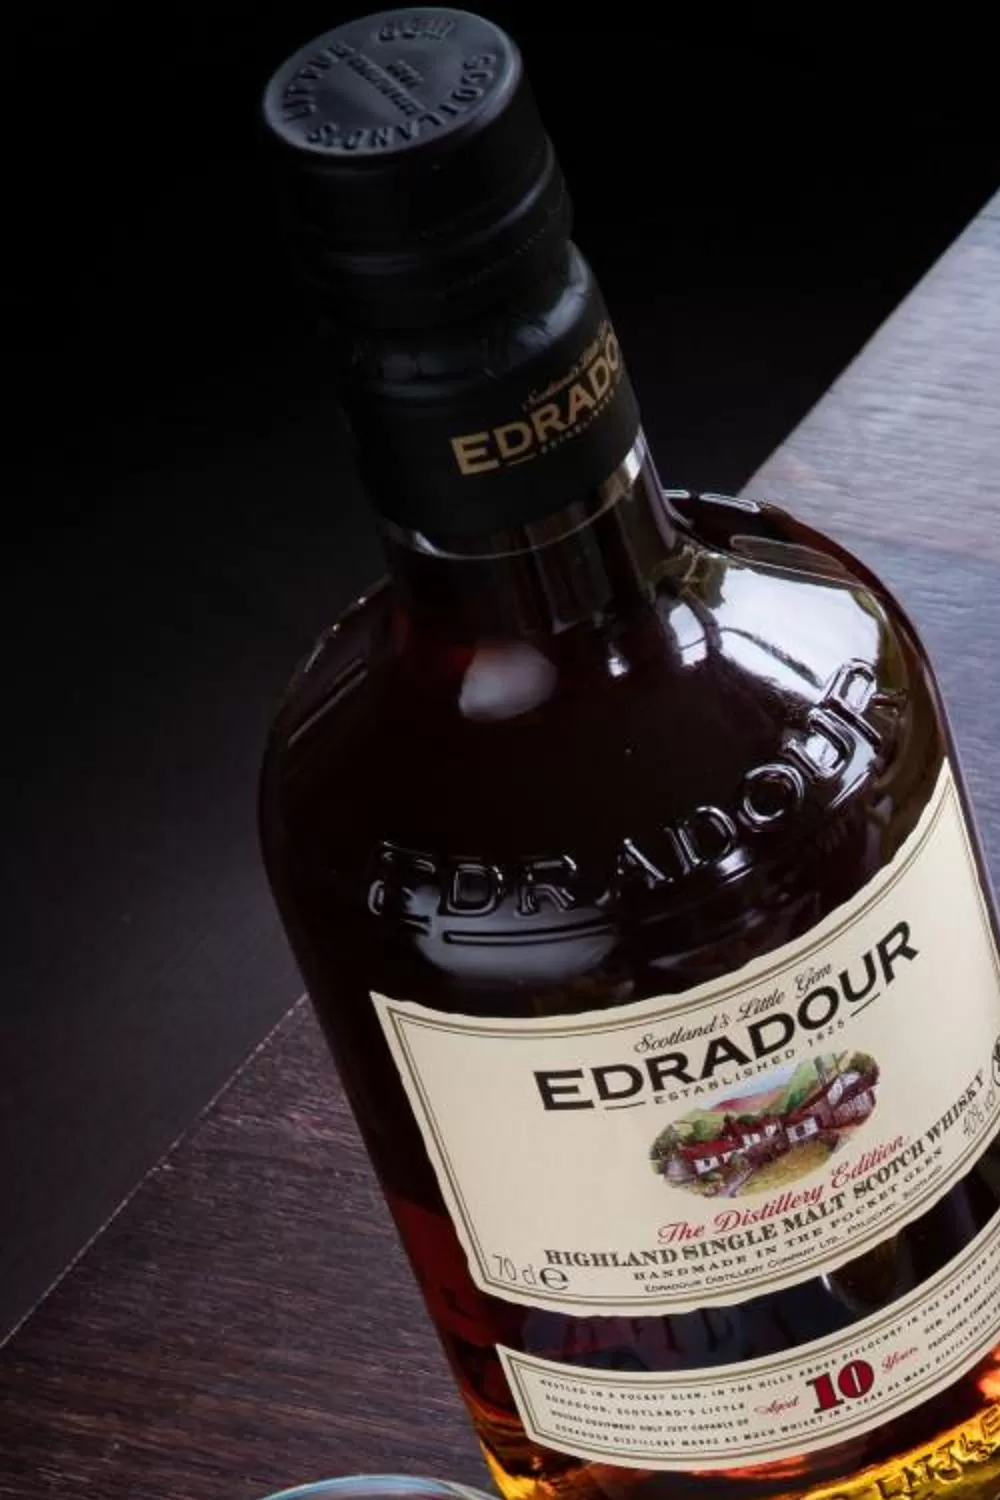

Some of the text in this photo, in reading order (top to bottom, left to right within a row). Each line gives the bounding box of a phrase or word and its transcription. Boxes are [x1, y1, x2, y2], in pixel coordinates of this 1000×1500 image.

[450, 332, 621, 476] EDRADO
[533, 920, 920, 1111] EDRADOUR
[633, 963, 833, 1054] Scotland's Little Gem
[653, 1020, 845, 1105] ESTABLISHED 1825
[543, 1068, 985, 1268] HIGHLAND SINGLE MALT SCOTCH WHISKY
[633, 1146, 943, 1281] HANDMADE IN THE POCKET GLEN
[656, 1135, 904, 1245] The Distillery Edition
[491, 1253, 518, 1282] 70
[805, 1358, 876, 1415] 10
